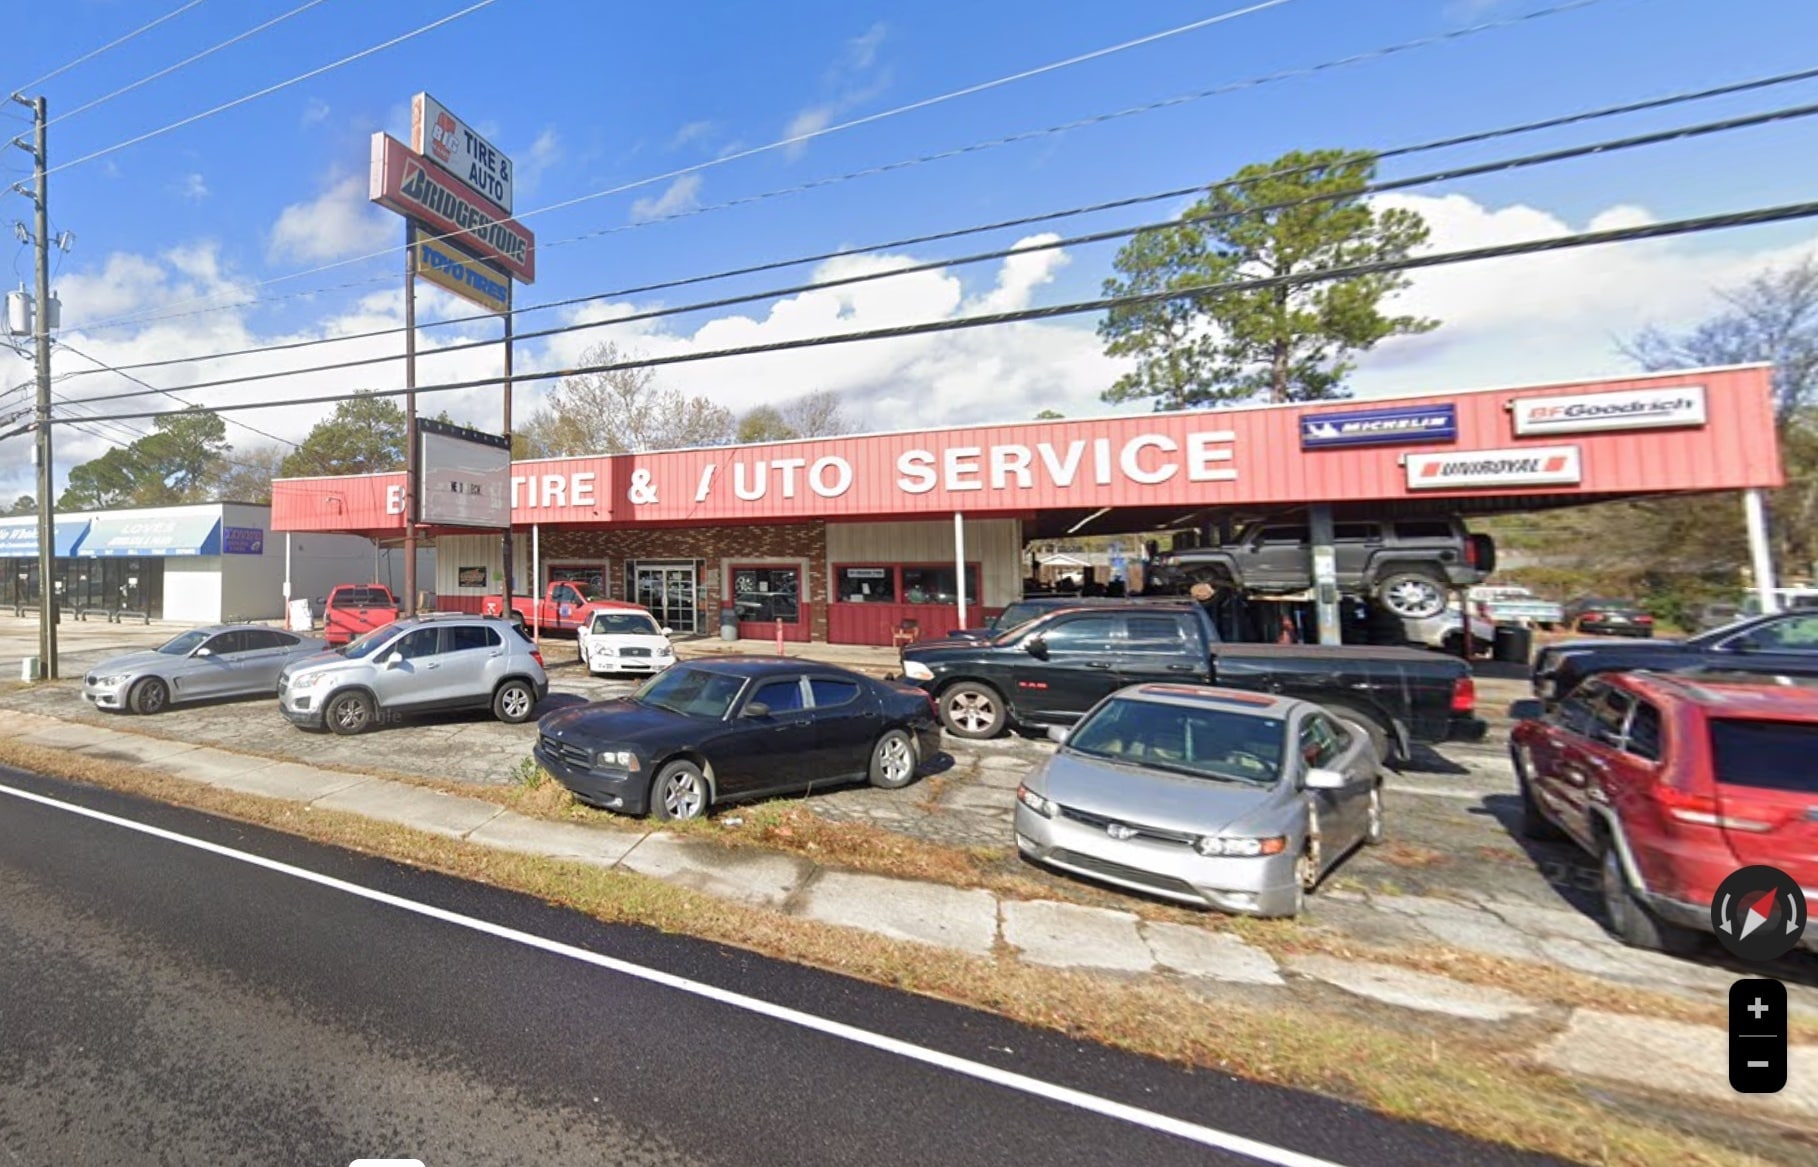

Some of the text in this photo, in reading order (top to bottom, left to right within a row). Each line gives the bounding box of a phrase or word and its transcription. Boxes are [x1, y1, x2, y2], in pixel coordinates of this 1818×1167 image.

[431, 122, 460, 154] BIG
[464, 130, 496, 173] TIRE
[500, 160, 509, 182] &
[469, 162, 503, 201] AUTO
[401, 168, 527, 264] BRIDGESTONE
[421, 245, 507, 304] TOYO TIRES
[1341, 416, 1448, 432] MICHELIN
[1528, 398, 1694, 419] BFGoodrich
[511, 472, 596, 508] TIRE
[628, 468, 659, 505] &
[897, 430, 1238, 494] SERVICE
